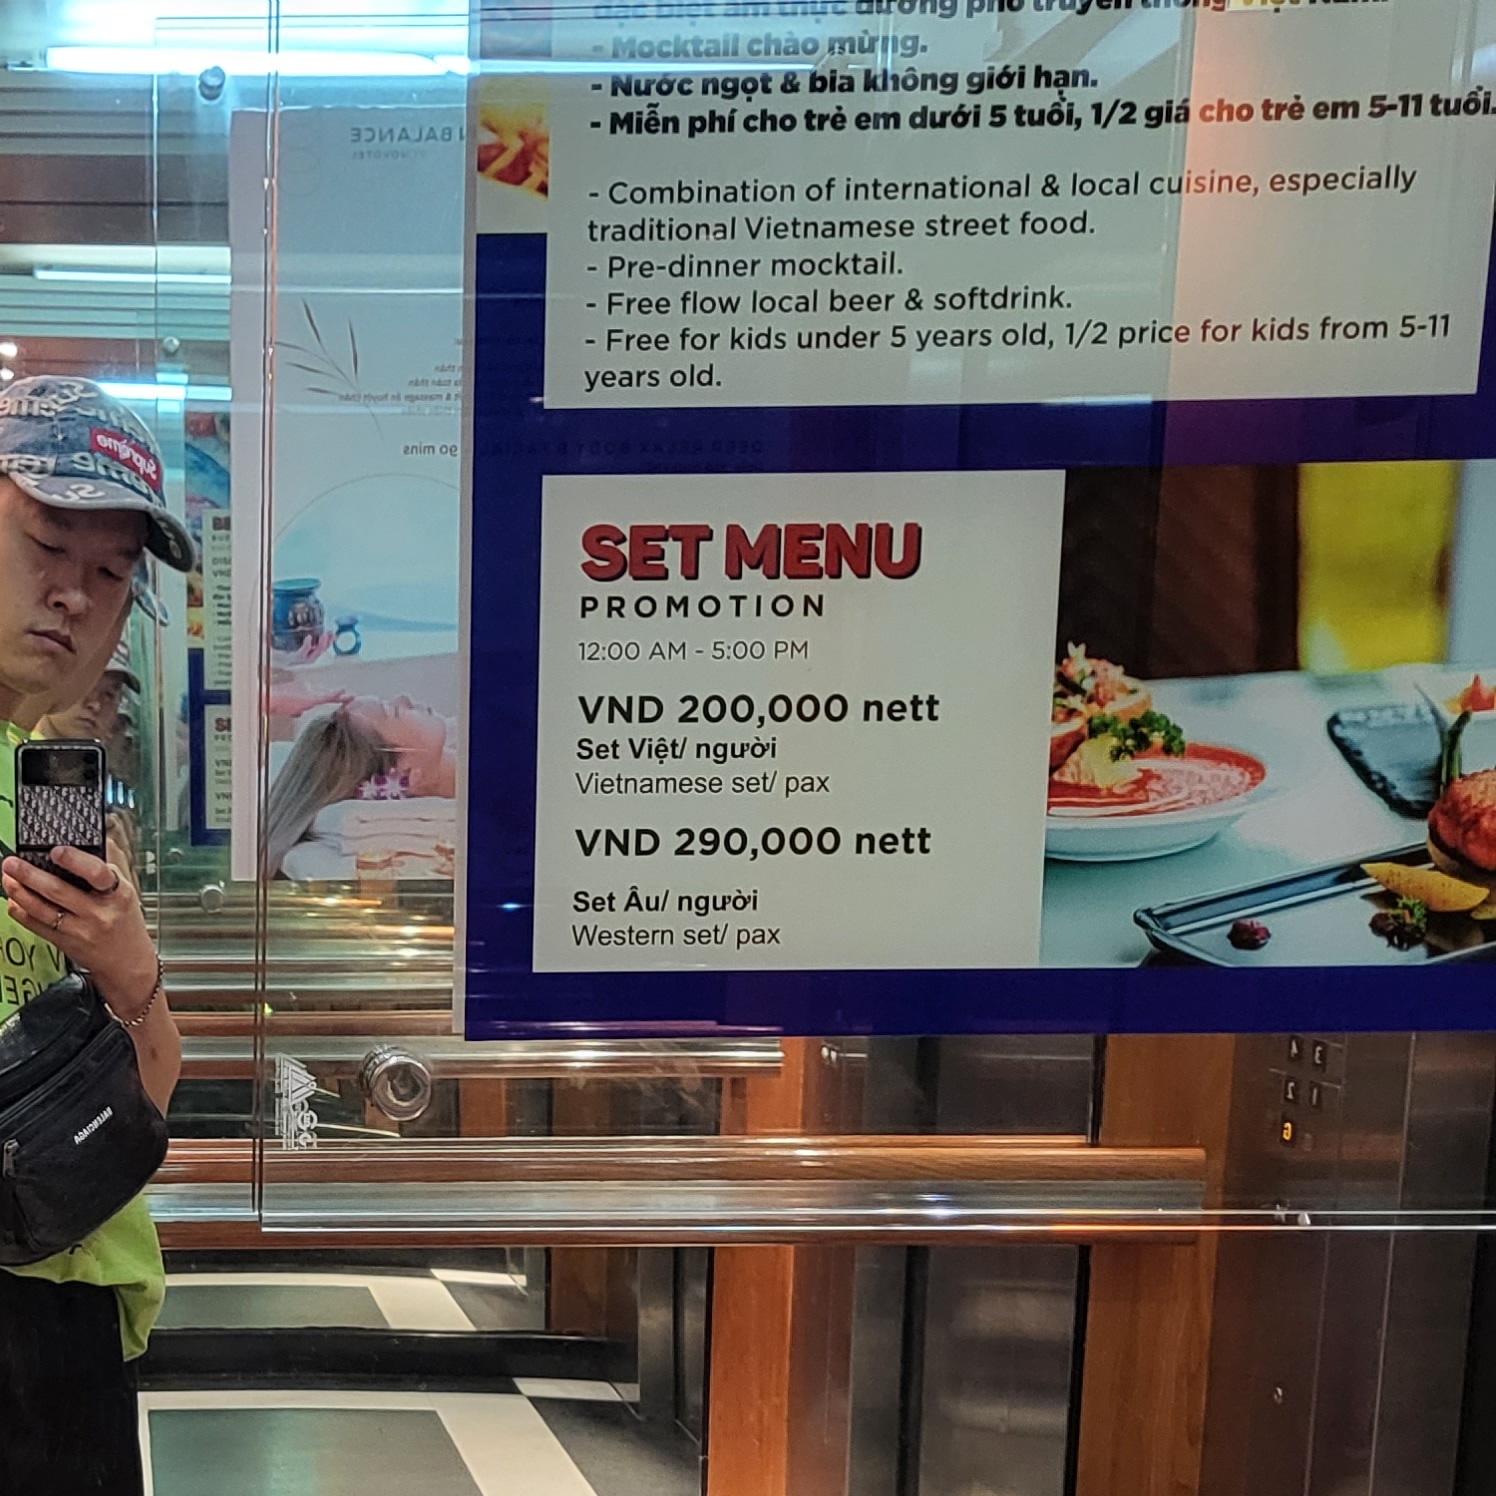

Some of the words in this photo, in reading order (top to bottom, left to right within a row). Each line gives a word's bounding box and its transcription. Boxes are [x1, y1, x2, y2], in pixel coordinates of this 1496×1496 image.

[611, 33, 739, 58] Mocktail
[747, 31, 820, 57] chào
[827, 30, 928, 58] mừng.
[702, 72, 772, 102] ngọt
[780, 71, 801, 95] &
[809, 69, 855, 94] bia
[862, 66, 958, 95] không
[966, 65, 1025, 95] giới
[1033, 65, 1098, 96] hạn.
[610, 102, 680, 135] Miễn
[688, 107, 736, 138] phí
[743, 107, 797, 133] cho
[804, 103, 847, 131] trẻ
[854, 110, 901, 131] em
[908, 103, 981, 130] dưới
[988, 104, 1007, 127] 5
[1014, 95, 1083, 131] tuổi,
[1091, 99, 1137, 128] 1/2
[1144, 98, 1191, 130] giá
[1199, 97, 1254, 124] cho
[1262, 94, 1304, 121] trẻ
[1312, 100, 1359, 120] em
[1368, 93, 1422, 118] 5-11
[608, 179, 796, 206] Combination
[805, 177, 836, 202] of
[844, 174, 1031, 202] international
[1040, 174, 1061, 198] &
[1071, 171, 1139, 197] local
[1149, 169, 1260, 196] cuisine,
[1269, 164, 1417, 197] especially
[587, 216, 737, 243] traditional
[745, 213, 916, 240] Vietnamese
[924, 212, 1010, 238] street
[1020, 209, 1096, 236] food.
[607, 254, 761, 279] Pre-dinner
[770, 250, 904, 278] mocktail.
[606, 292, 671, 316] Free
[681, 290, 741, 315] flow
[751, 288, 818, 314] local
[829, 288, 895, 313] beer
[903, 287, 924, 312] &
[933, 283, 1073, 311] softdrink.
[606, 328, 670, 352] Free
[679, 326, 720, 351] for
[730, 325, 787, 351] kids
[797, 324, 880, 350] under
[889, 325, 907, 348] 5
[915, 328, 993, 352] years
[1001, 322, 1054, 350] old,
[1065, 320, 1108, 349] 1/2
[1118, 319, 1191, 349] price
[1201, 318, 1242, 343] for
[1251, 316, 1310, 342] kids
[1319, 314, 1388, 340] from
[1399, 313, 1450, 338] 5-11
[583, 368, 661, 392] years
[668, 363, 722, 388] old.
[580, 524, 712, 582] SET
[724, 522, 922, 580] MENU
[579, 594, 825, 619] PROMOTION
[578, 641, 641, 662] 12:00
[648, 641, 687, 661] AM
[711, 640, 765, 661] 5:00
[773, 640, 810, 661] PM
[578, 695, 665, 725] VND
[677, 693, 849, 729] 200,000
[862, 693, 940, 722] nett
[575, 738, 620, 761] Set
[627, 735, 687, 766] Việt/
[694, 735, 778, 765] người
[575, 772, 723, 795] Vietnamese
[730, 770, 778, 794] set/
[784, 774, 831, 798] pax
[575, 828, 661, 857] VND
[673, 826, 841, 862] 290,000
[854, 826, 932, 855] nett
[572, 890, 616, 913] Set
[623, 884, 669, 913] Âu/
[676, 888, 759, 916] người
[571, 924, 674, 947] Western
[682, 922, 728, 946] set/
[735, 927, 781, 950] pax
